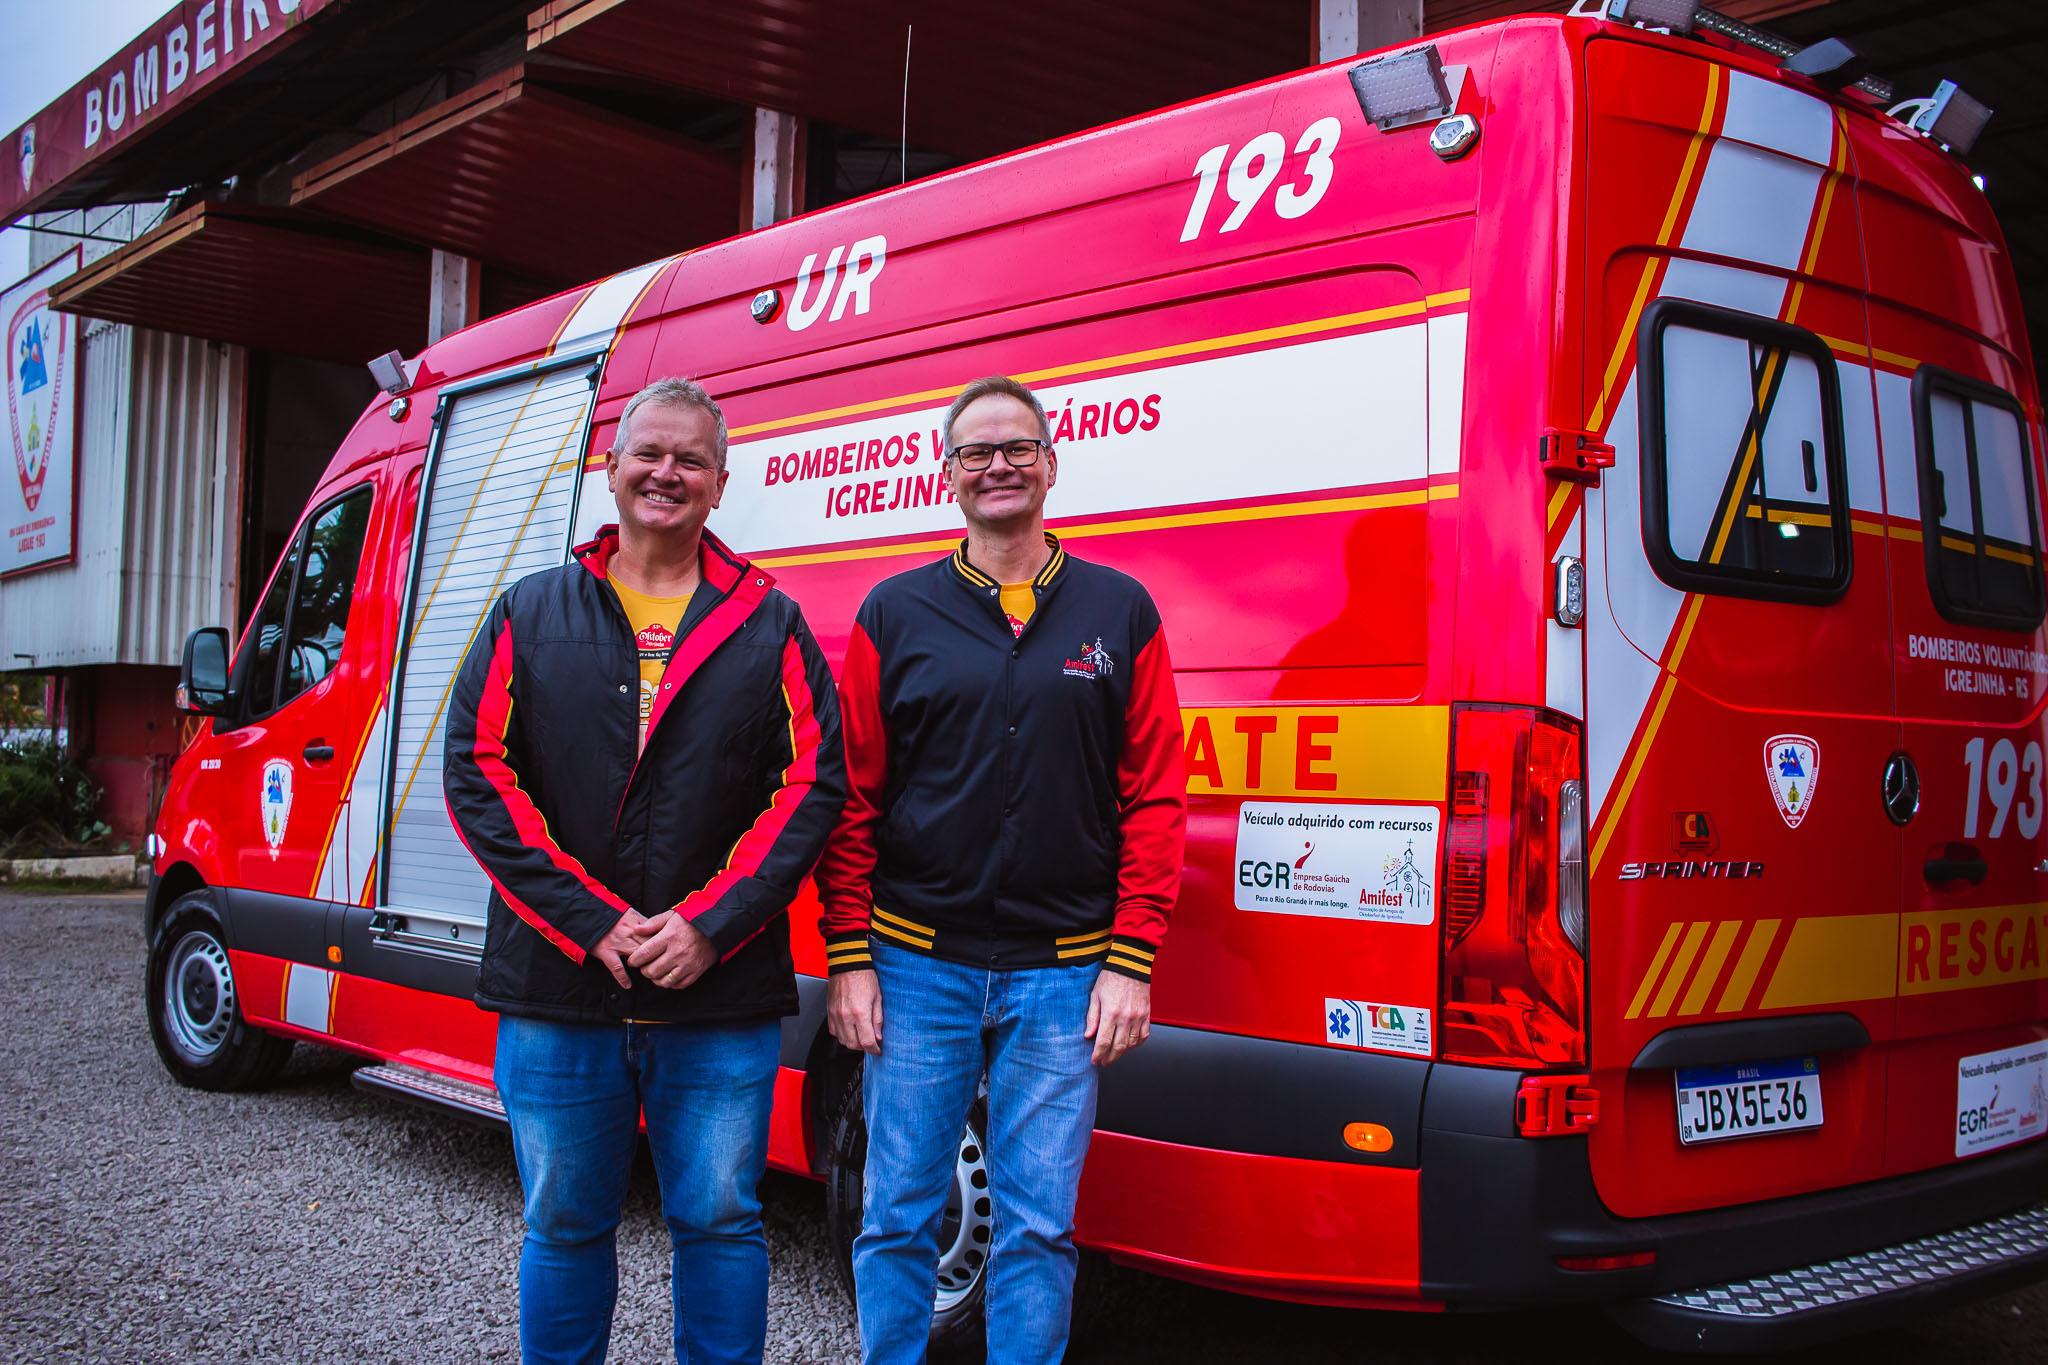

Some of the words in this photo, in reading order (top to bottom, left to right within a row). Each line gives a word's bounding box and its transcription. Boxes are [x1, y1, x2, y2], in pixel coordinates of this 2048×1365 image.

[84, 0, 300, 149] BOMBEIR
[1180, 116, 1342, 244] 193
[786, 234, 887, 332] UR
[765, 432, 921, 486] BOMBEIROS
[825, 472, 958, 518] IGREJINH
[1909, 634, 1981, 664] BOMBEIROS
[1064, 658, 1095, 673] Amifest
[1945, 668, 2007, 696] IGREJINHA
[2015, 677, 2029, 699] RS
[1964, 737, 2043, 840] 193
[1243, 810, 1285, 825] Veículo
[1287, 812, 1344, 830] adquirido
[1349, 819, 1375, 830] com
[1379, 820, 1433, 832] recursos
[1239, 860, 1291, 889] EGR
[1293, 873, 1323, 883] Empresa
[1324, 873, 1350, 884] Gaúcha
[1618, 861, 1765, 880] SPRINTER
[1255, 894, 1269, 902] Para
[1286, 896, 1307, 905] Grande
[1308, 898, 1314, 906] ir
[1314, 899, 1329, 907] mais
[1293, 883, 1302, 891] de
[1303, 884, 1335, 893] Rodovias
[1359, 888, 1403, 907] Amifest
[1906, 915, 2048, 983] RESGA
[1367, 1005, 1405, 1031] TCA
[1737, 1068, 1760, 1079] BRASIL
[1694, 1080, 1808, 1133] JBX5E36
[1959, 1106, 1988, 1136] EGR
[1684, 1125, 1693, 1139] BR
